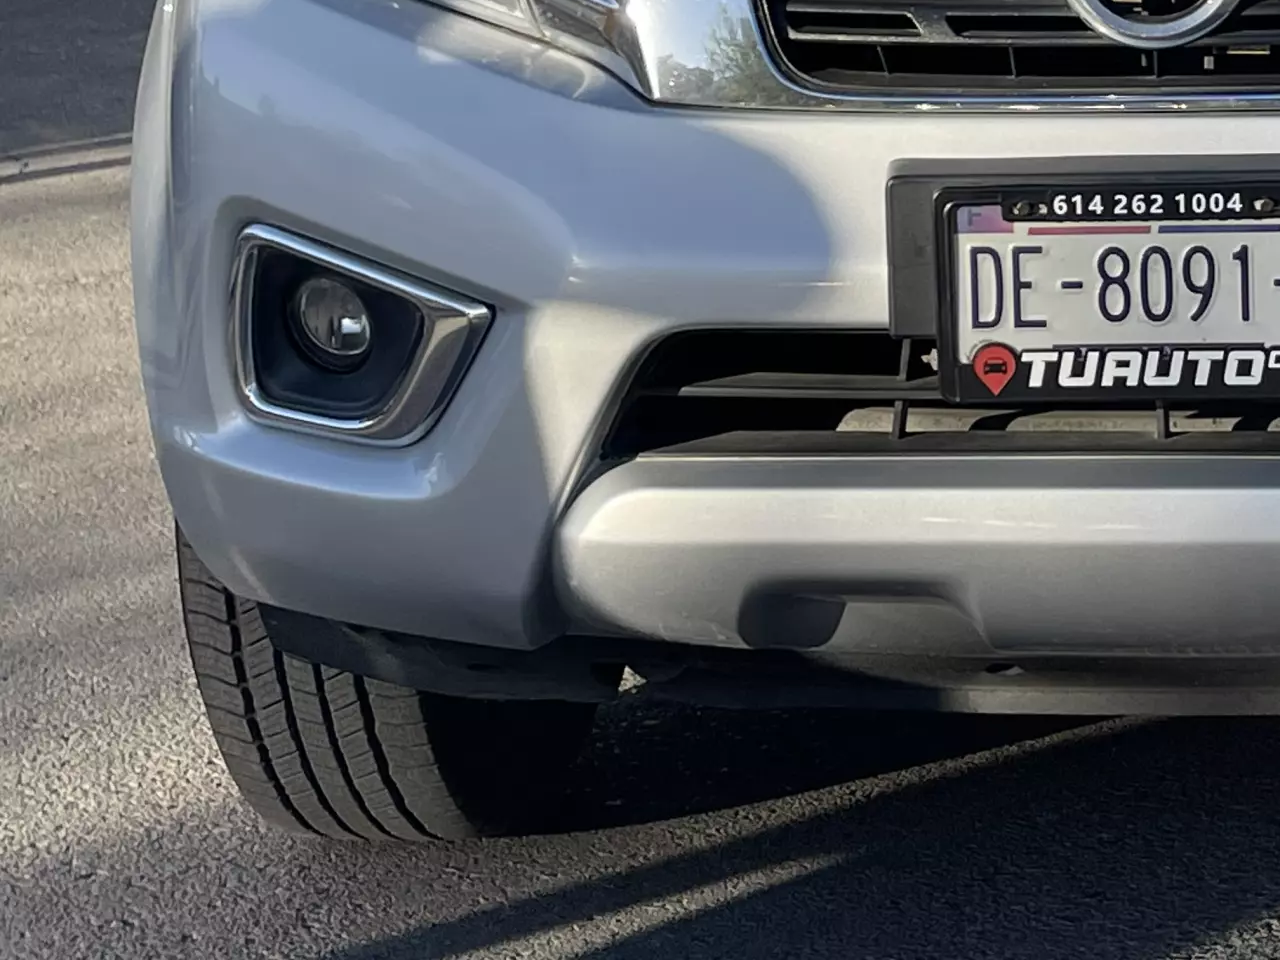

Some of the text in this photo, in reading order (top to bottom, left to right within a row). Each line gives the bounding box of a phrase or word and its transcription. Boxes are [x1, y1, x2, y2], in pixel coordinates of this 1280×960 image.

[1053, 192, 1243, 215] 614 262 1004
